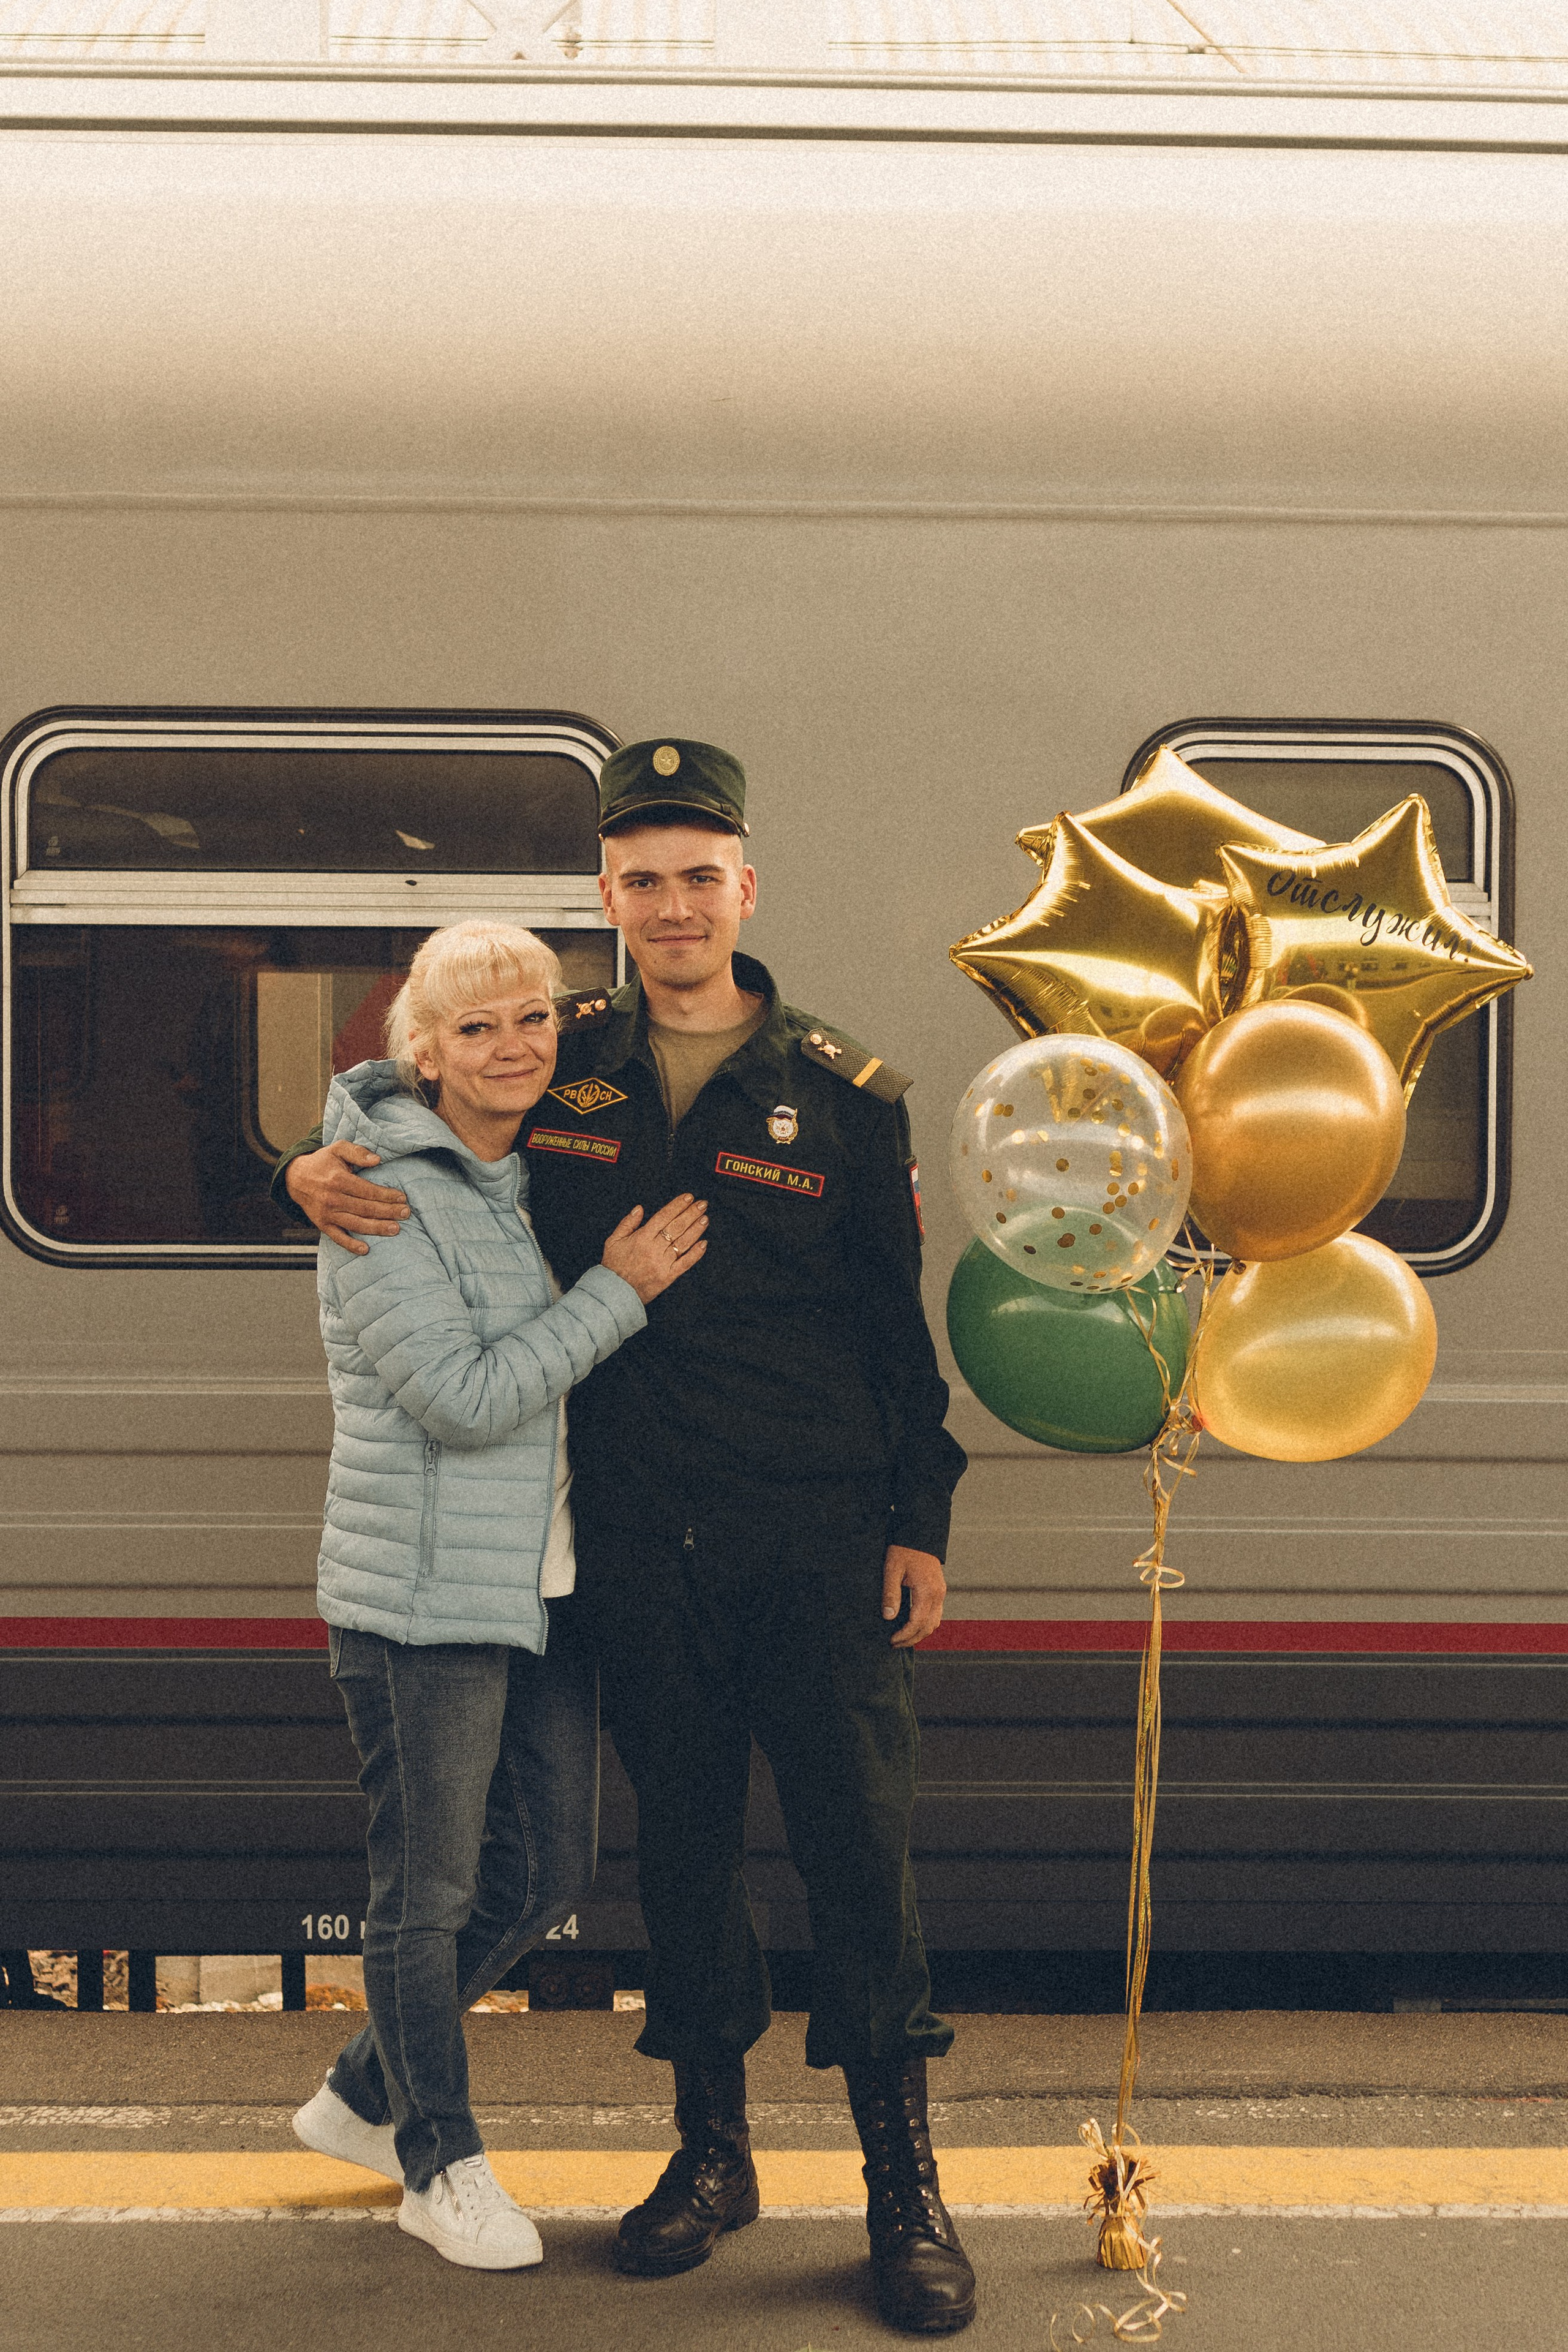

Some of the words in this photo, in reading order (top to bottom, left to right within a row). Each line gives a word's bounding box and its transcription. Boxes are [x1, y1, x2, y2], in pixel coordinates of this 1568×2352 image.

[564, 1089, 577, 1099] РВ
[600, 1090, 612, 1101] СН
[531, 1133, 573, 1148] ВООРУЖЕННЫЕ
[573, 1139, 590, 1151] СИЛЫ
[590, 1142, 617, 1157] РОССИИ
[725, 1159, 781, 1182] ГОНСКИЙ
[787, 1174, 814, 1190] М.А.
[301, 1913, 350, 1940] 160
